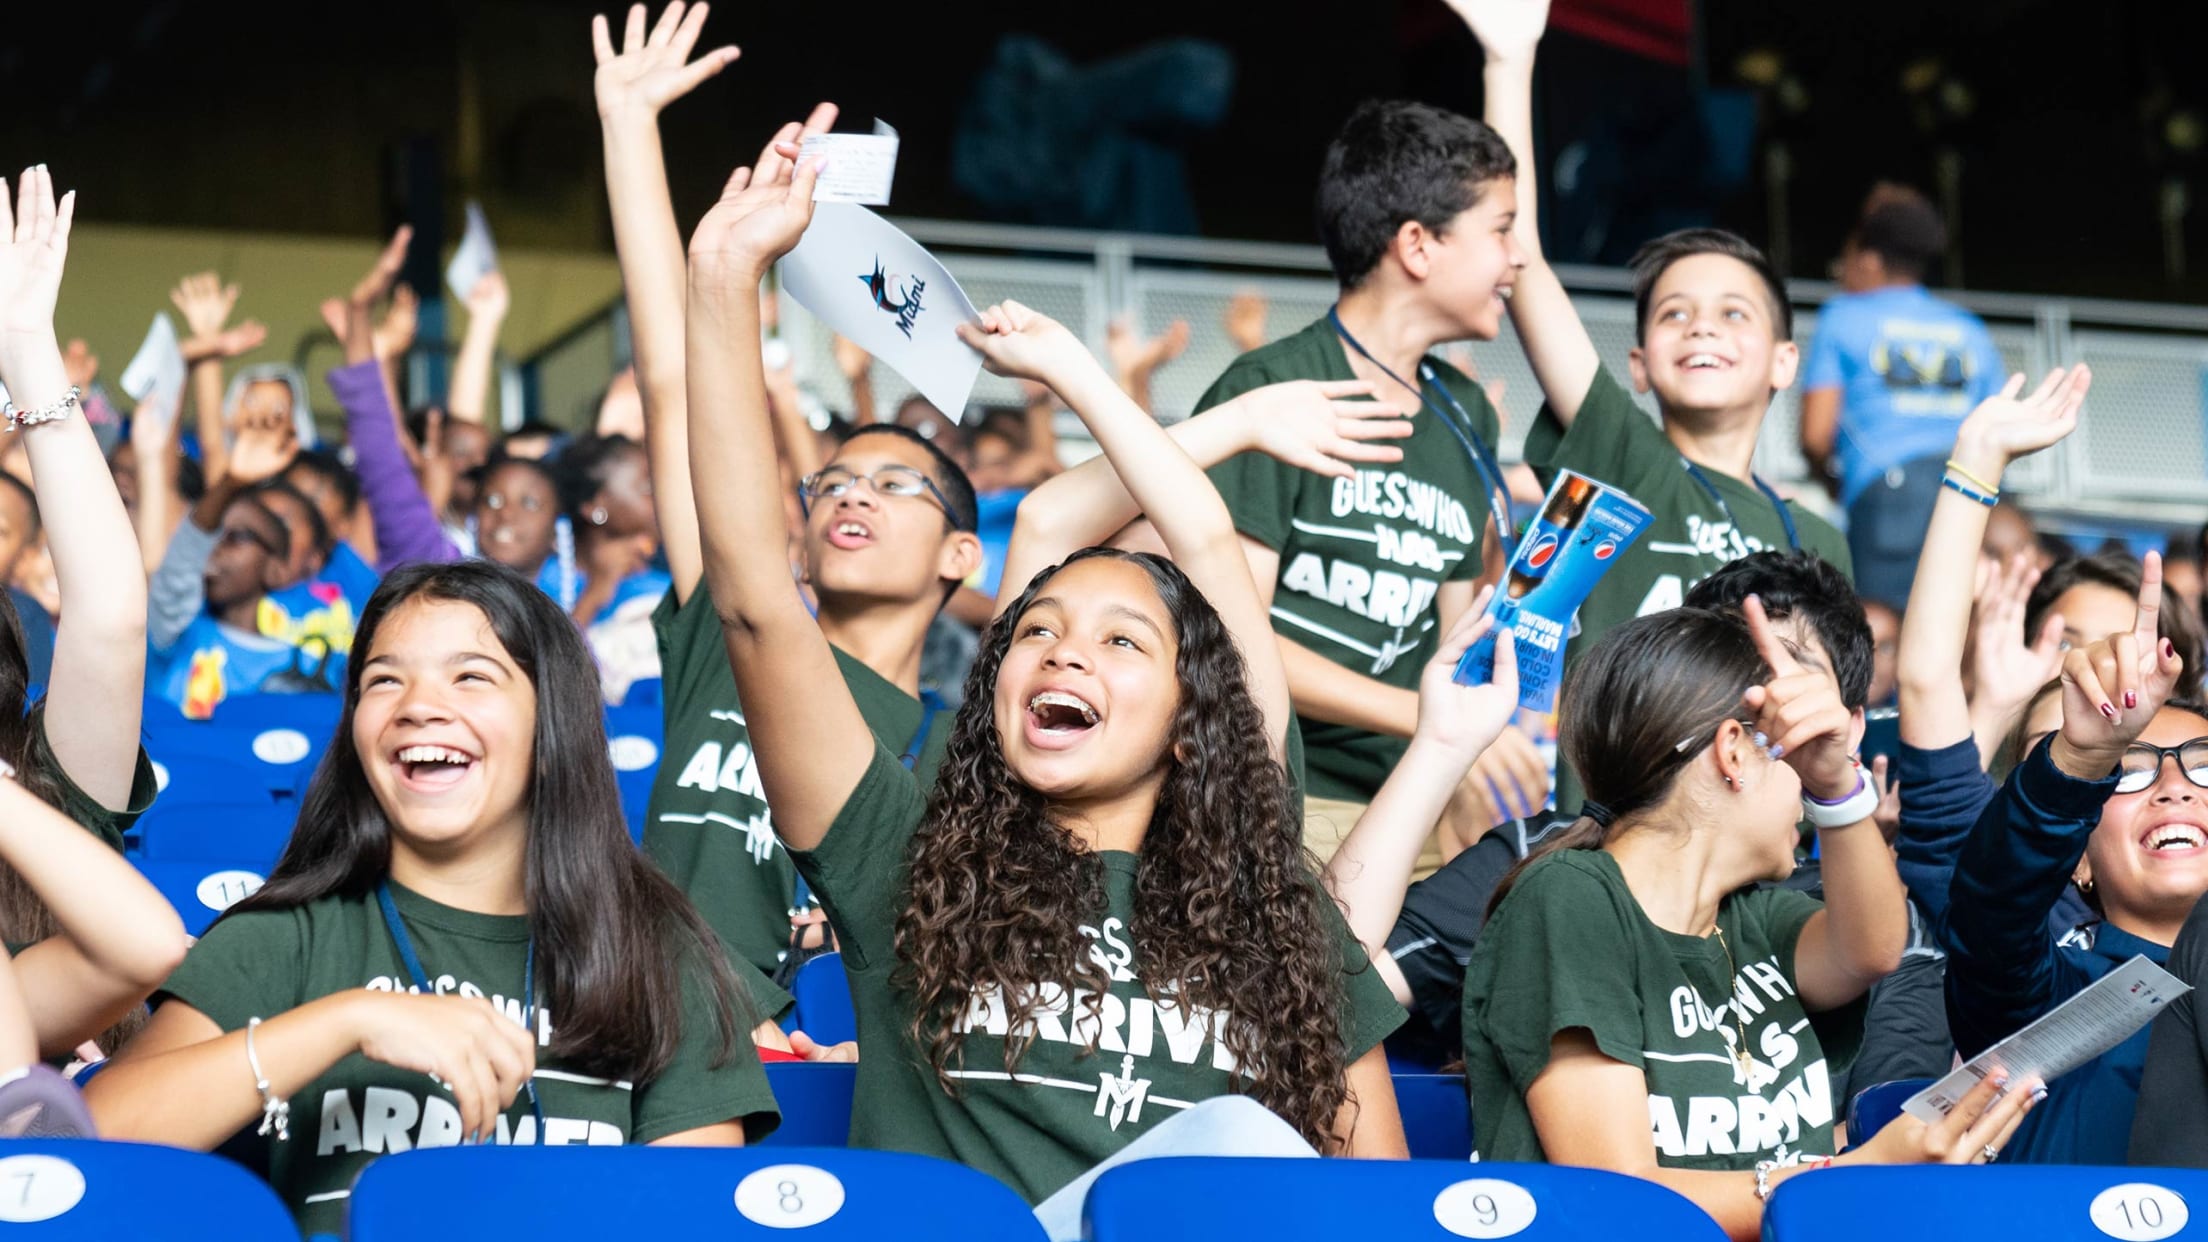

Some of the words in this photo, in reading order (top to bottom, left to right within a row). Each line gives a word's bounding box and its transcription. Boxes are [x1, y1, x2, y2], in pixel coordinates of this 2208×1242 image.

[895, 273, 926, 342] Miami
[1728, 954, 1796, 1026] WH
[11, 1171, 35, 1208] 7
[777, 1180, 804, 1214] 8
[1472, 1193, 1499, 1226] 9
[2114, 1196, 2164, 1230] 10
